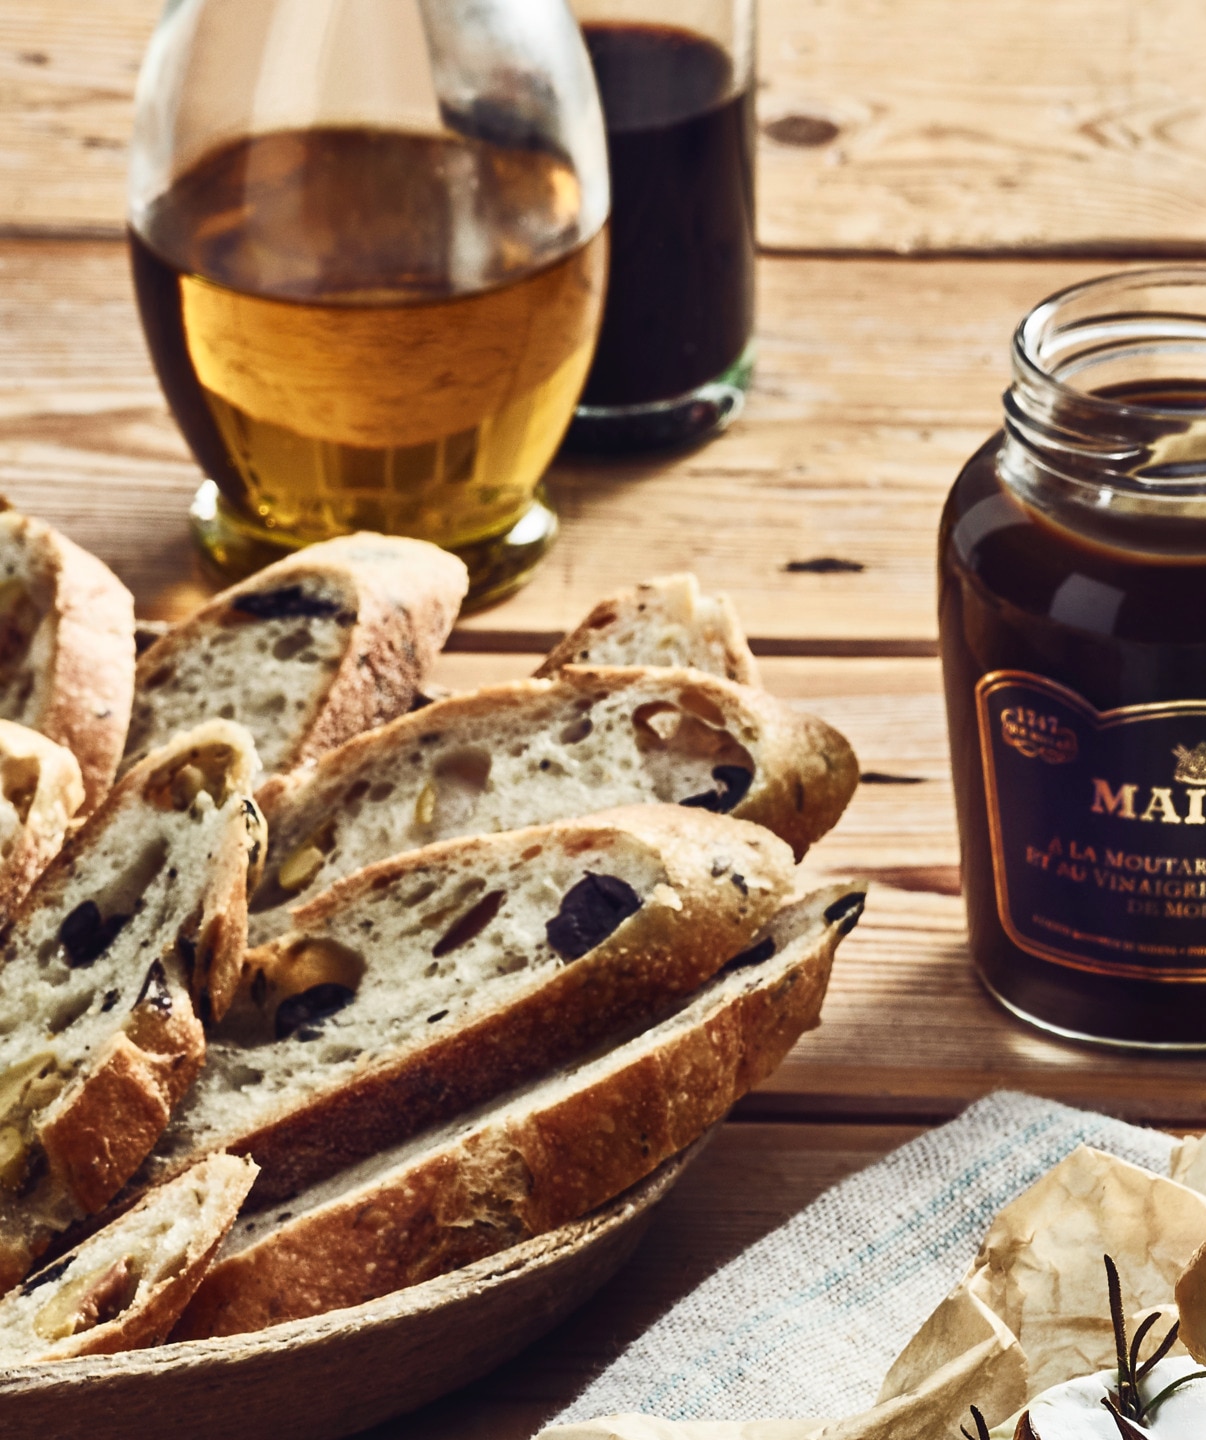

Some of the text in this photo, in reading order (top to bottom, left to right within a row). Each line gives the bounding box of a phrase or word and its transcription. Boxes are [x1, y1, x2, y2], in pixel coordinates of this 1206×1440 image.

[1070, 840, 1097, 863] LA
[1056, 861, 1088, 882] AU
[1127, 898, 1160, 916] DE
